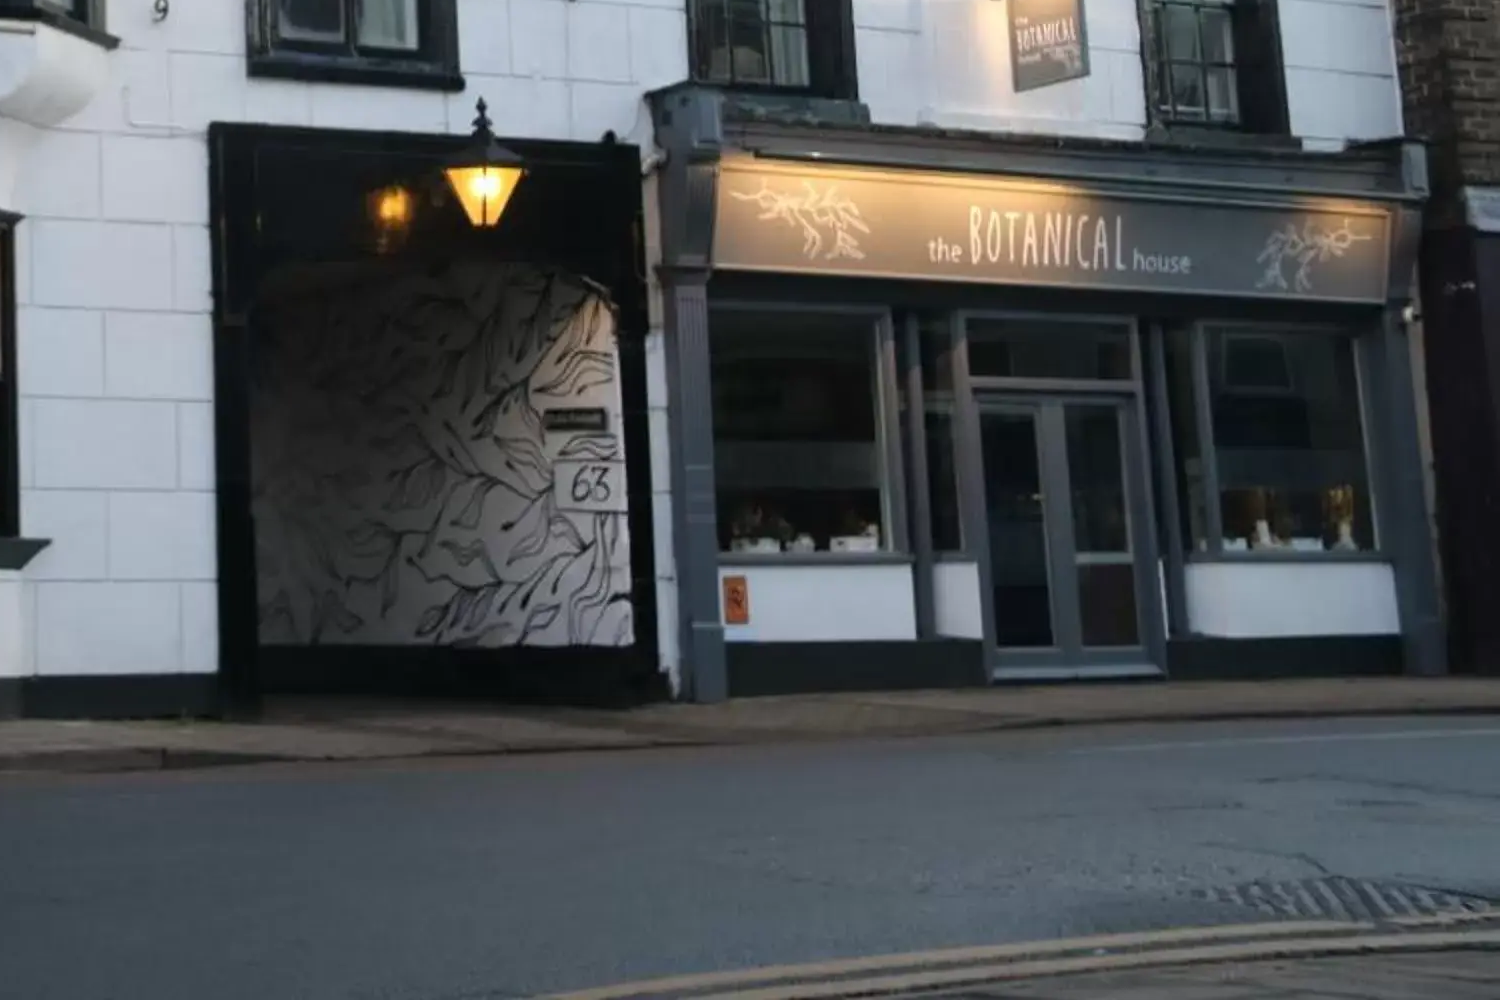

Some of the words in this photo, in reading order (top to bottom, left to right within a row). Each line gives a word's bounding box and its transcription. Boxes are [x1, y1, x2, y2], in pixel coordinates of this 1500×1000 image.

[927, 236, 963, 263] the
[969, 204, 1127, 271] BOTANICAL
[1132, 247, 1192, 275] house
[571, 465, 611, 502] 63
